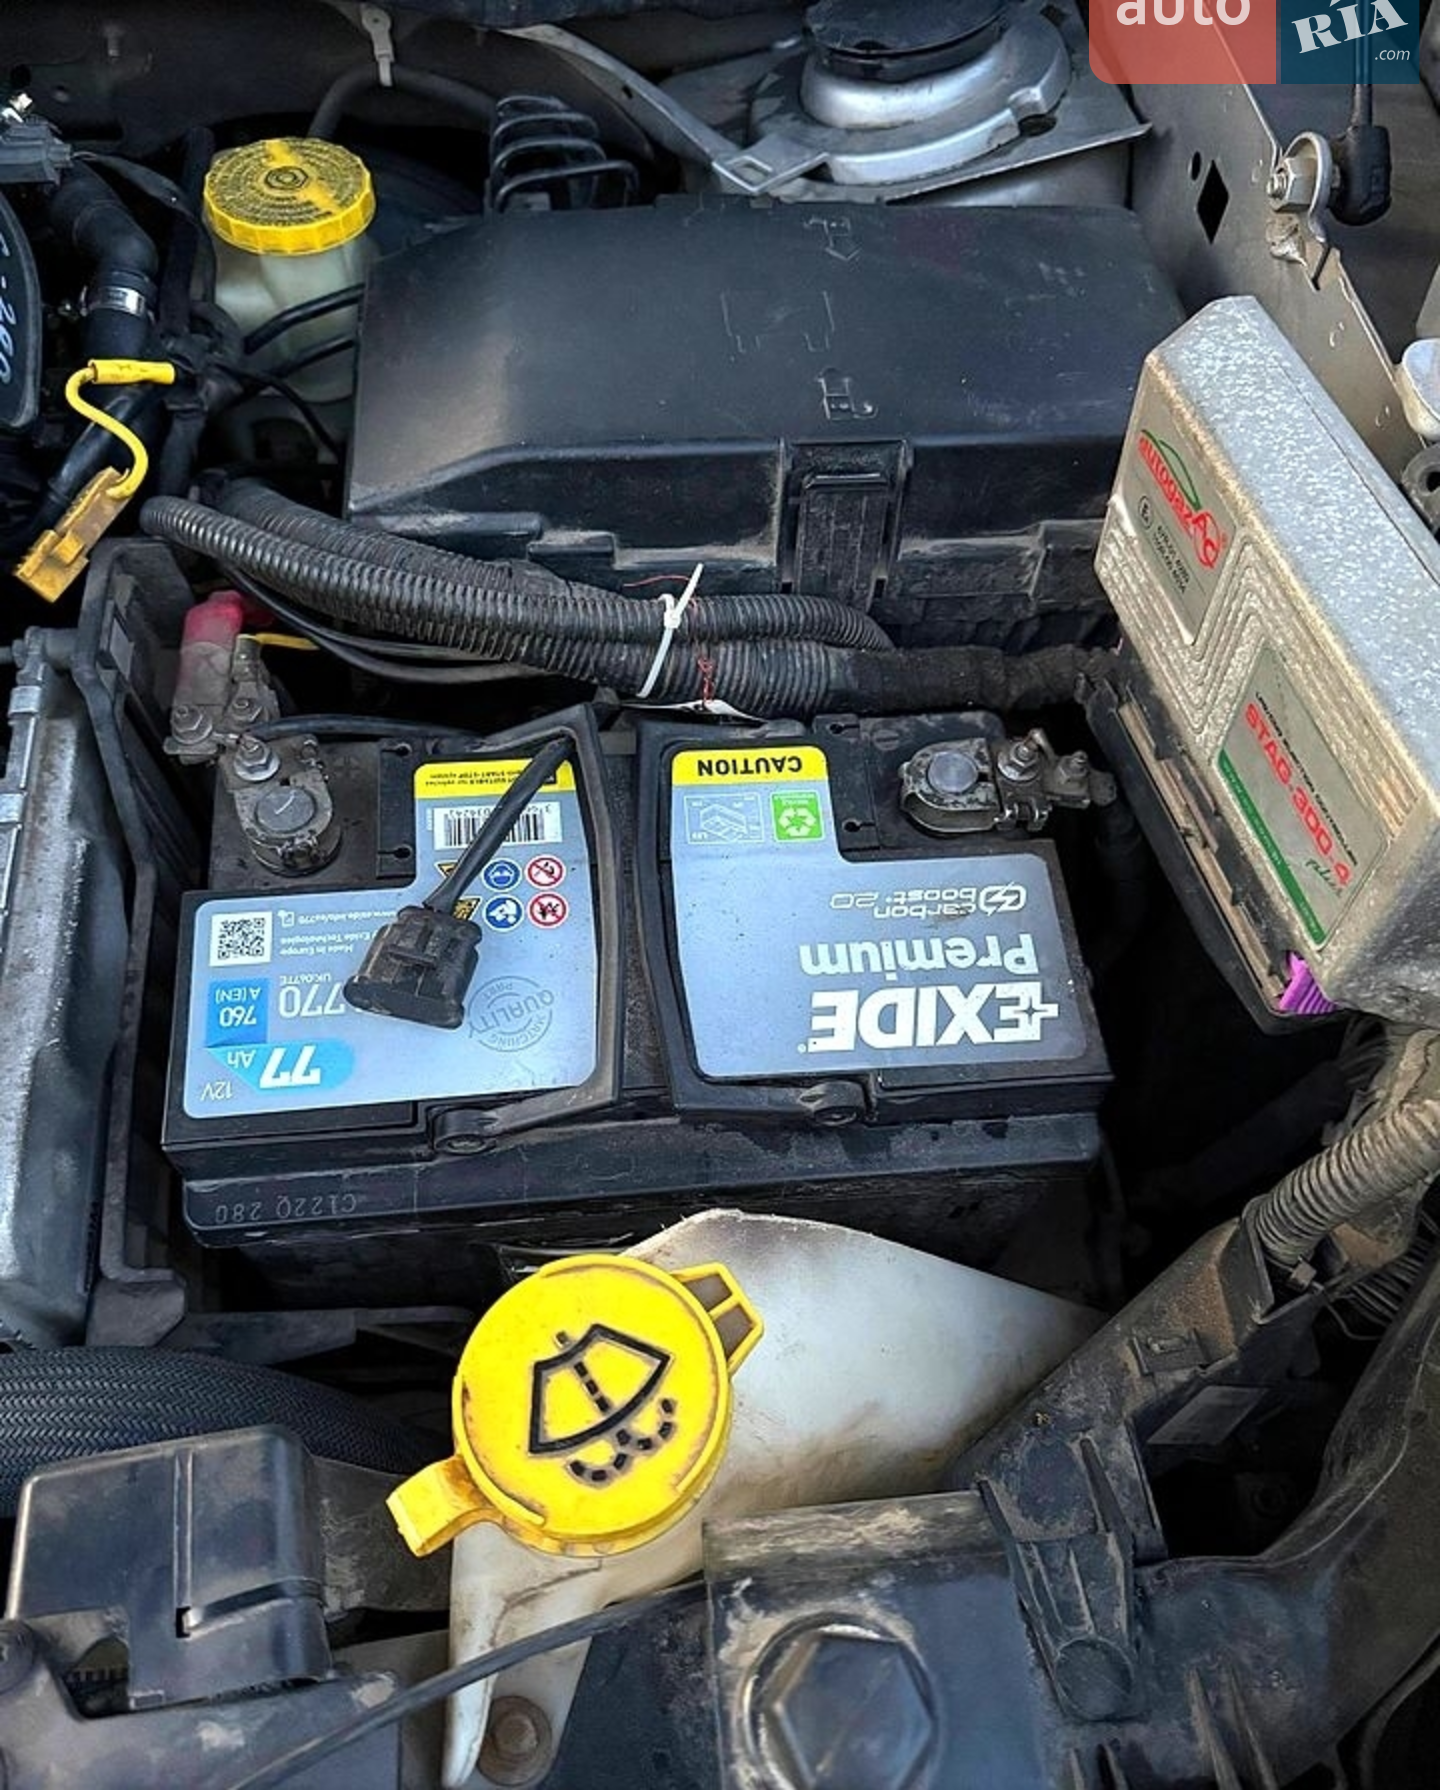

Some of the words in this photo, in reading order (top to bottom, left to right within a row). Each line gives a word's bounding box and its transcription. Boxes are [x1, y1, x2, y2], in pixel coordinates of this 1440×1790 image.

[697, 755, 802, 777] CAUTION
[892, 887, 977, 905] boost
[875, 902, 977, 920] carbon
[280, 934, 341, 946] Technologies
[327, 944, 354, 954] Made
[280, 946, 315, 956] Europe
[316, 946, 326, 954] in
[798, 933, 1039, 981] Premium
[215, 988, 247, 1003] (EN)
[249, 987, 261, 998] A
[481, 982, 513, 1001] PART
[219, 1005, 257, 1027] 760
[468, 990, 555, 1039] QUALITY
[807, 981, 1059, 1053] EXIDE
[227, 1049, 257, 1069] Ah
[258, 1045, 321, 1088] 77
[201, 1081, 233, 1101] 12V
